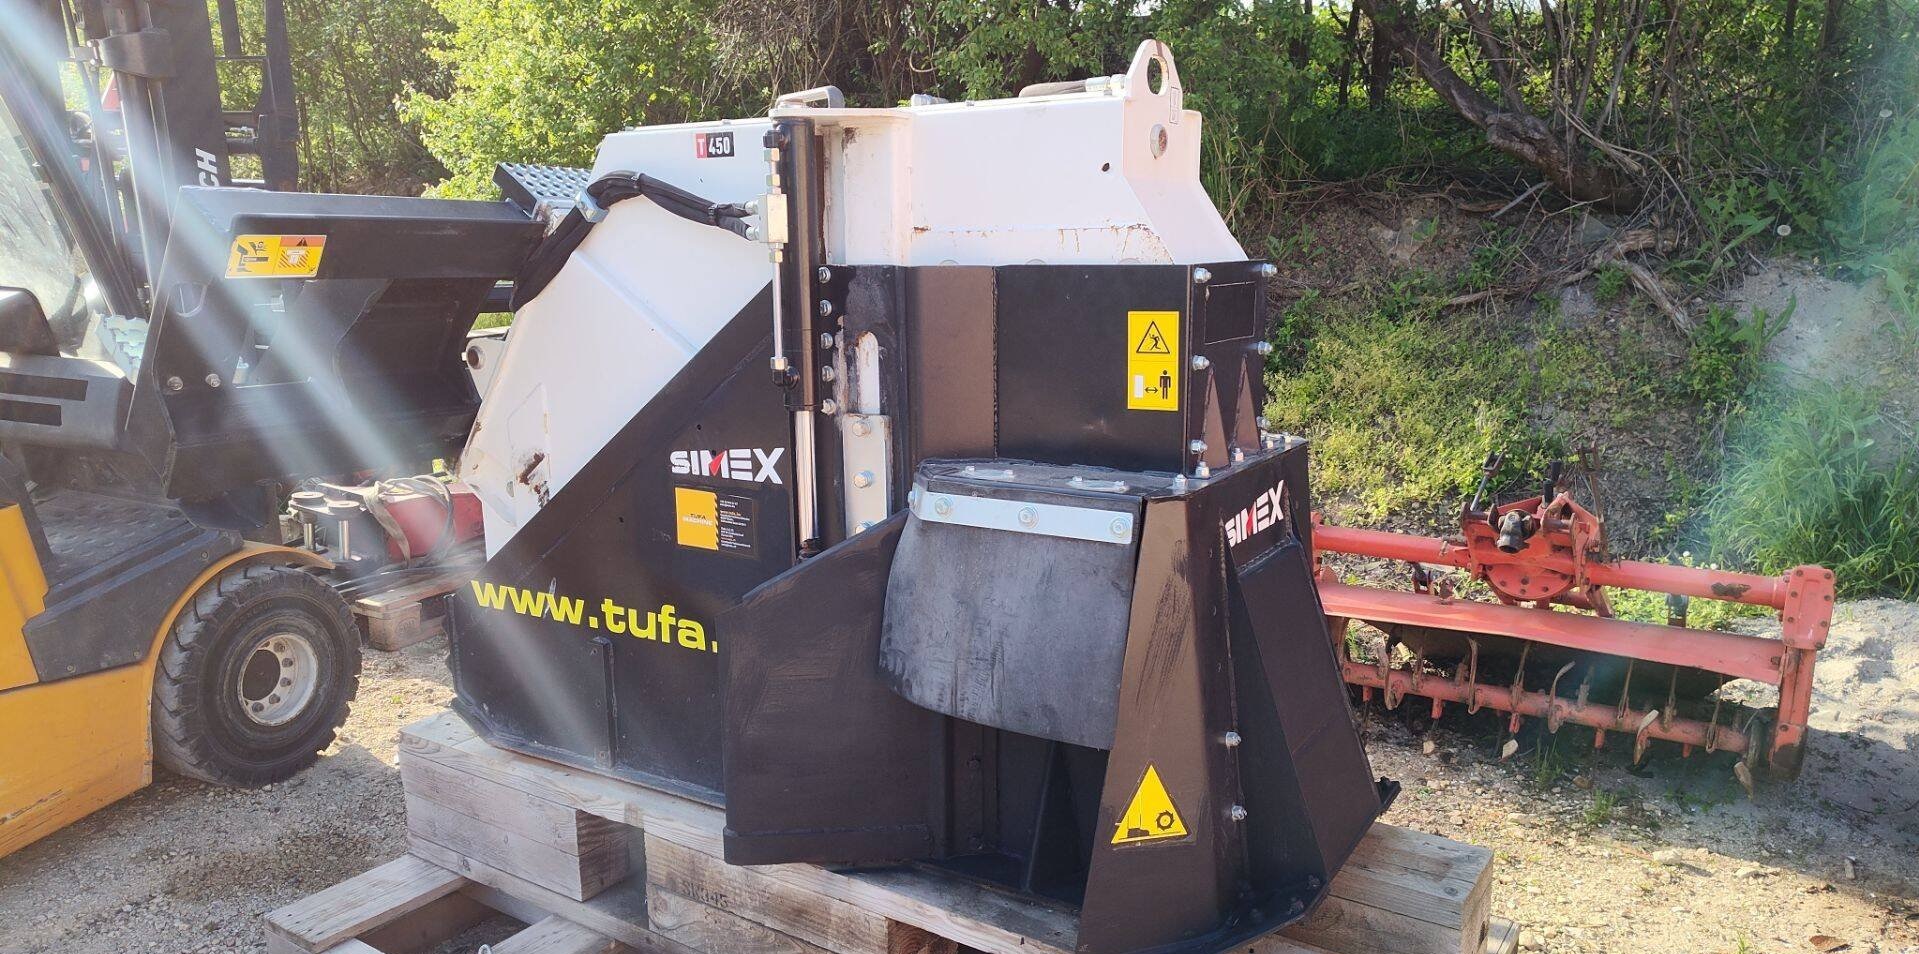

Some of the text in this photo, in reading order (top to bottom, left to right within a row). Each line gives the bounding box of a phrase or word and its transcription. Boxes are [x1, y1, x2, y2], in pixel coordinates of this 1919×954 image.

[697, 136, 731, 156] T 450
[669, 447, 785, 485] SIMEX
[1225, 479, 1285, 548] SIMEX
